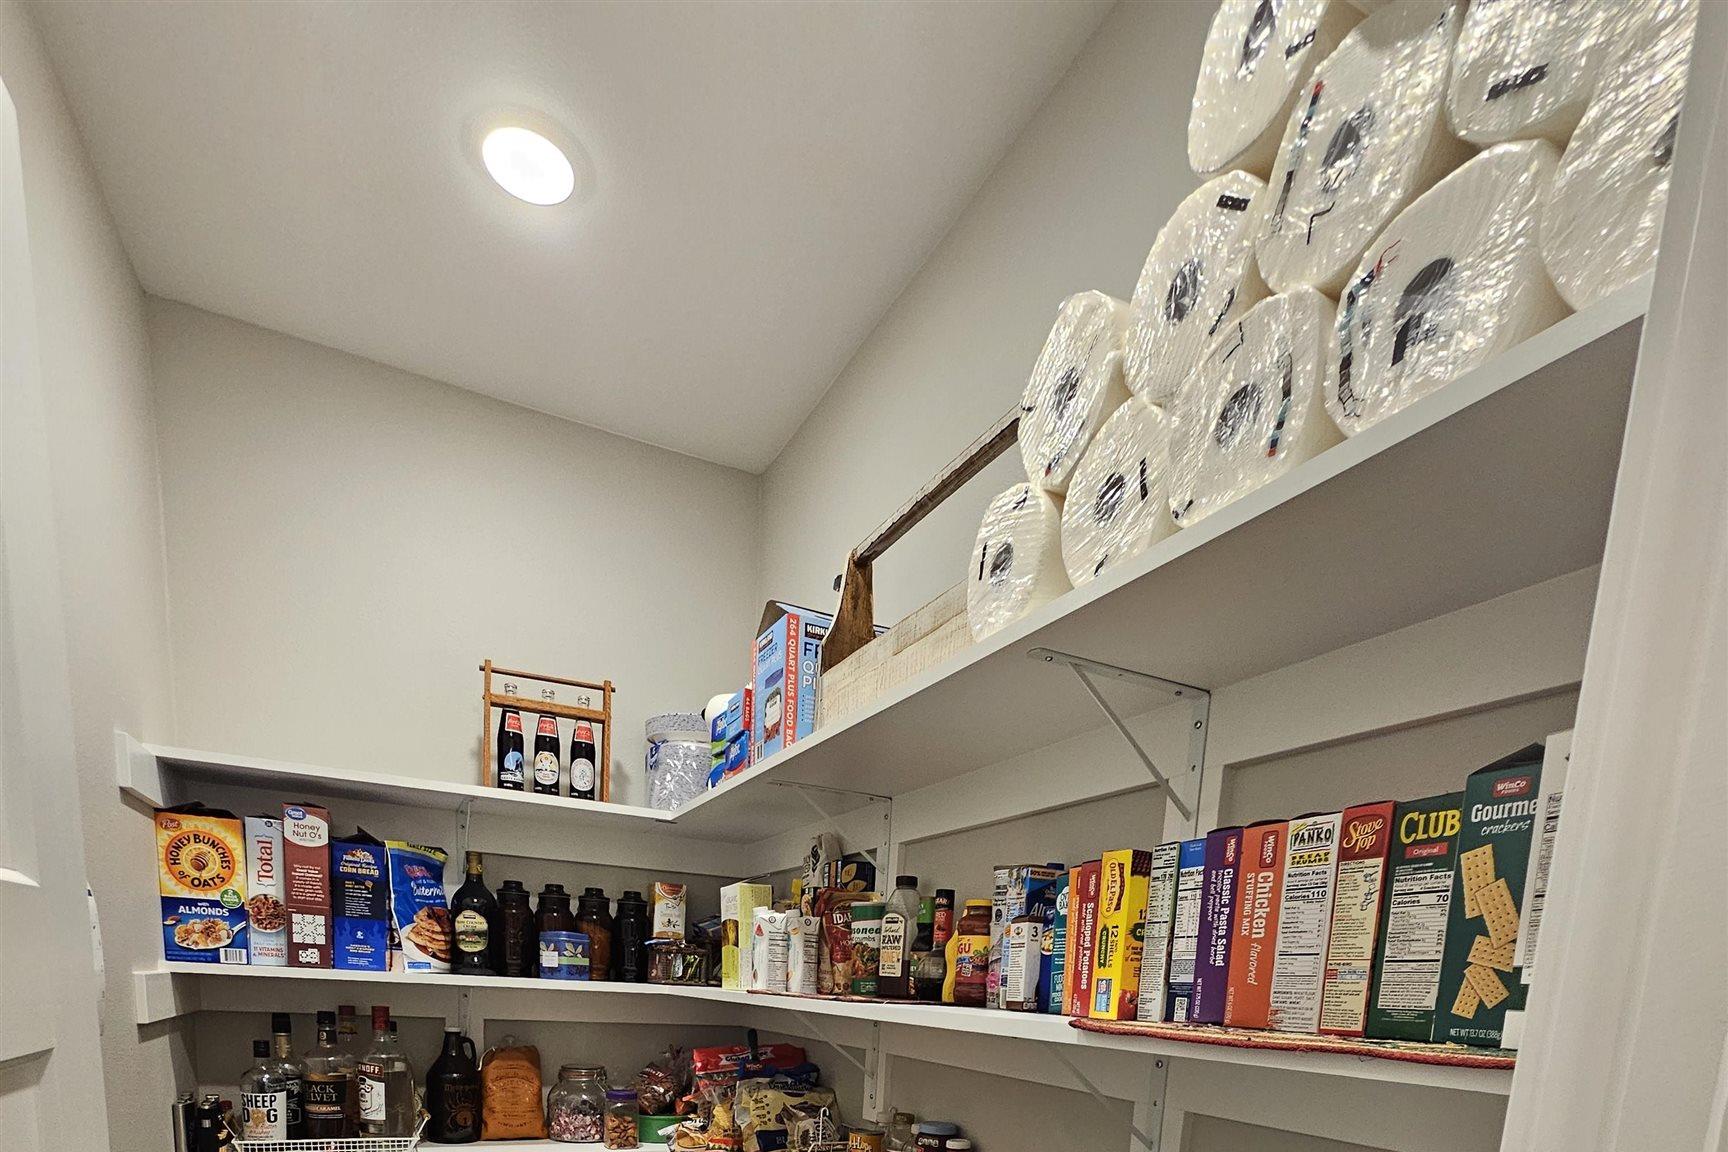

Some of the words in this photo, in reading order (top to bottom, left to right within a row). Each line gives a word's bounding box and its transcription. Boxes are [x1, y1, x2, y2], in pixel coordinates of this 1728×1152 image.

[789, 618, 798, 636] 264
[787, 639, 797, 672] QUART
[787, 674, 796, 698] PLUS
[786, 700, 796, 727] FOOD
[1497, 780, 1527, 791] WinCo
[161, 819, 179, 829] Post
[293, 822, 320, 832] Honey
[1400, 809, 1461, 844] CLUB
[1481, 819, 1531, 835] crackers
[292, 830, 307, 838] Nut
[309, 831, 322, 839] O's
[1293, 829, 1331, 846] PANKO
[1343, 819, 1384, 848] Stove
[170, 834, 191, 866] HONEY
[193, 833, 231, 870] BUNCHES
[1265, 835, 1275, 863] WinCo
[1355, 834, 1376, 853] Top
[1413, 846, 1440, 856] Original
[257, 839, 273, 882] Total
[1291, 852, 1330, 861] BREAD
[1291, 857, 1329, 866] CRUMBS
[178, 870, 190, 881] of
[191, 873, 226, 888] OATS
[357, 867, 379, 876] BREAD
[1109, 863, 1118, 879] OLD
[1395, 875, 1427, 883] Nutrition
[1220, 868, 1233, 905] Classic
[1243, 873, 1255, 916] STUFFING
[1311, 890, 1327, 898] 110
[1252, 872, 1274, 939] Chicken
[1436, 894, 1449, 902] 70
[178, 905, 229, 916] ALMONDS
[1083, 902, 1095, 948] Scalloped
[1217, 907, 1230, 937] Pasta
[1241, 918, 1251, 936] MIX
[882, 935, 902, 945] RAW
[1032, 926, 1039, 938] 3
[1111, 925, 1119, 938] 12
[1099, 931, 1107, 964] CRUNCHY
[1107, 939, 1115, 968] SHELLS
[1214, 938, 1226, 967] Salad
[1080, 950, 1091, 990] Potatoes
[1247, 942, 1261, 985] flavored
[1450, 1028, 1460, 1036] NET
[1460, 1029, 1469, 1038] WT
[241, 1093, 277, 1108] SHEEP
[243, 1108, 278, 1123] DG
